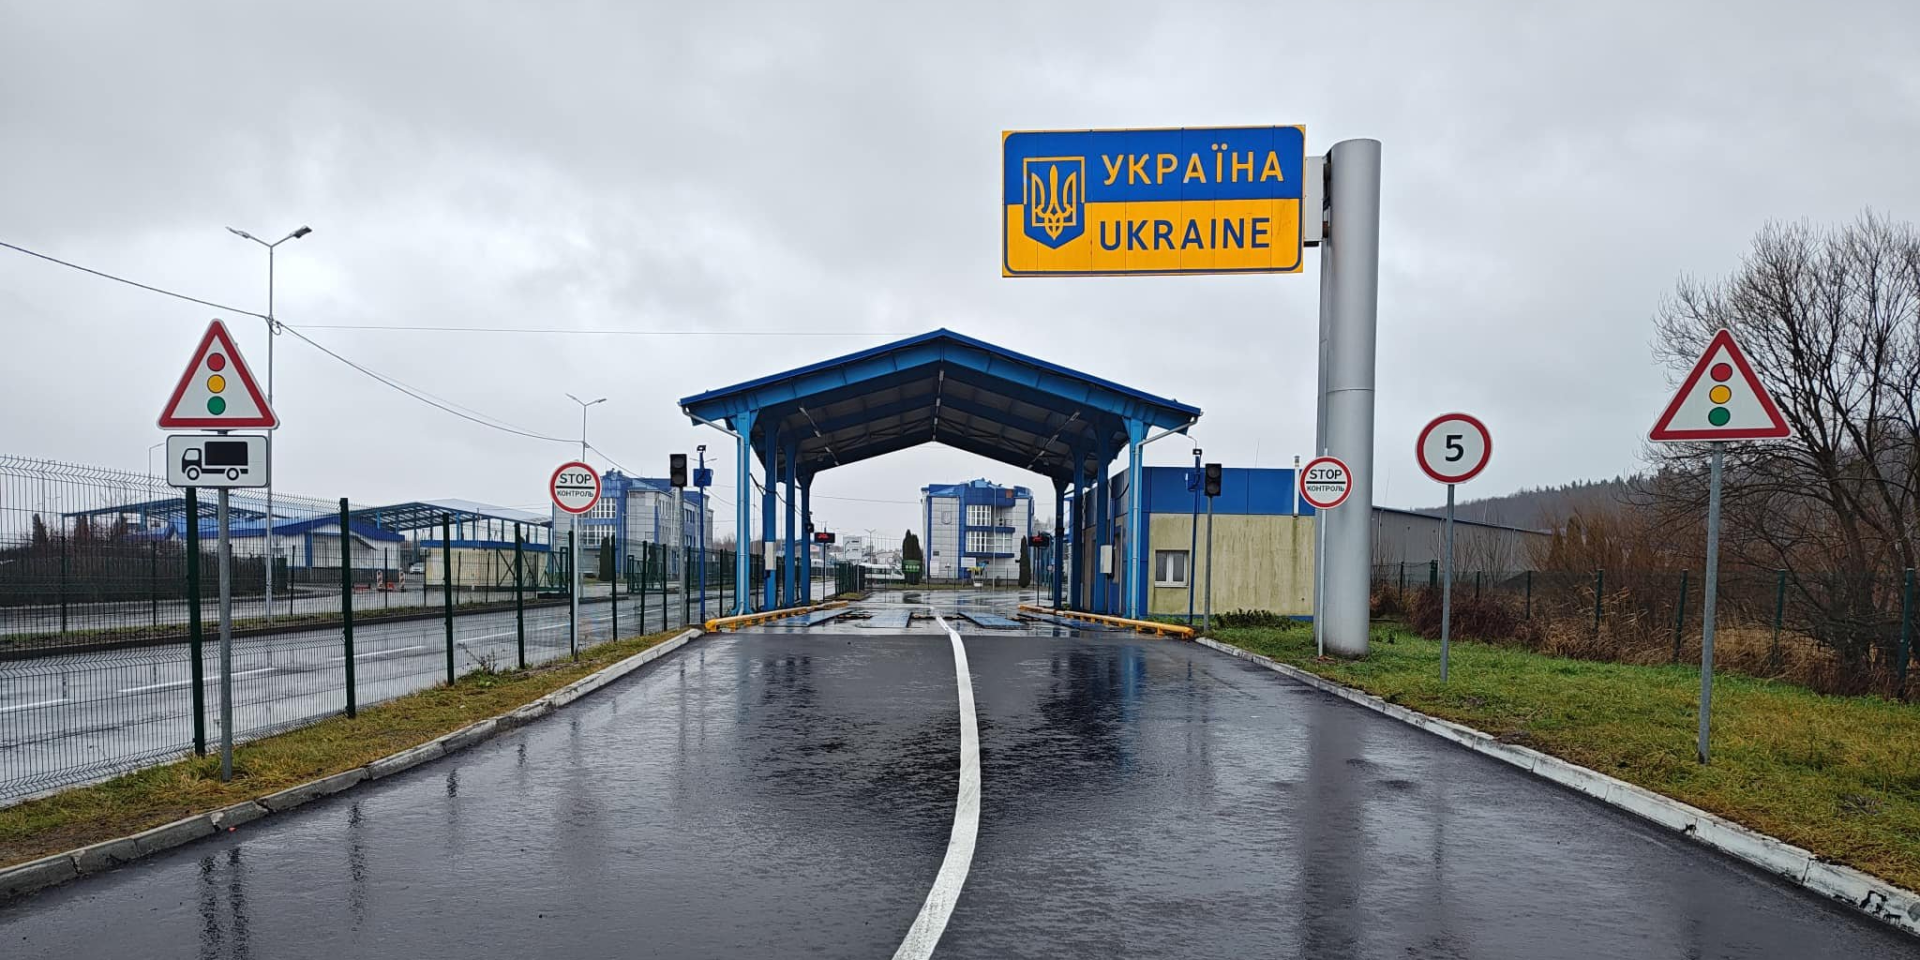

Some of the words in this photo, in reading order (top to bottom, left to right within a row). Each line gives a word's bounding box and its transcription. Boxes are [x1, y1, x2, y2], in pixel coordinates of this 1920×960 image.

[1101, 143, 1284, 186] УКРАЇНА
[1100, 217, 1270, 250] UKRAINE
[1445, 434, 1464, 462] 5
[559, 473, 592, 484] STOP
[1309, 469, 1343, 480] STOP
